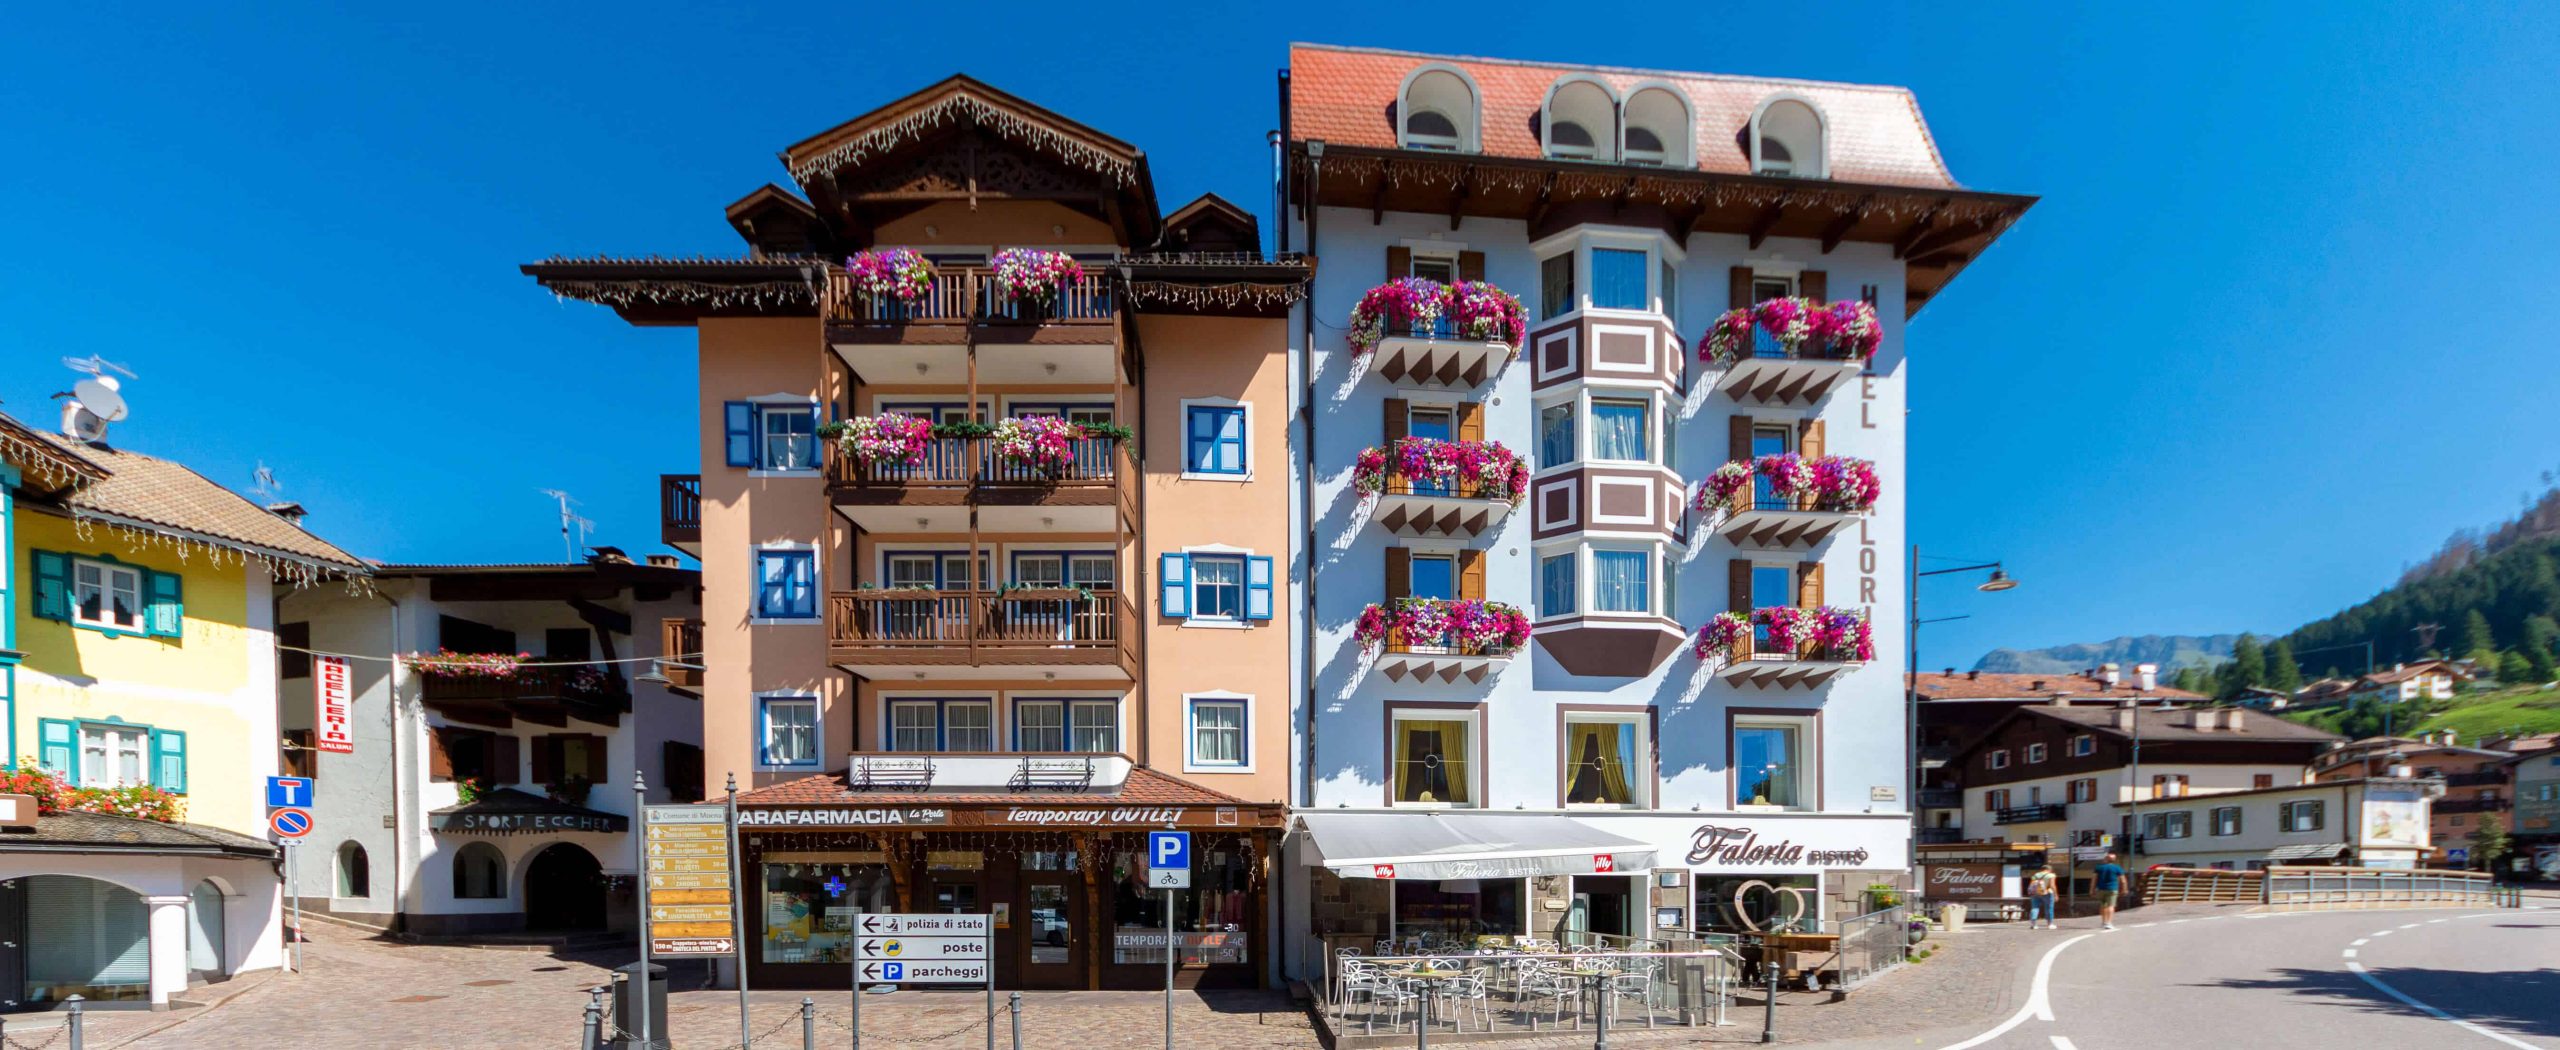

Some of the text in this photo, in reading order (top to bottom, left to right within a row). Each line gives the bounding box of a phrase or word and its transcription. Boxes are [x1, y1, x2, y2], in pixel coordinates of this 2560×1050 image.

[1861, 284, 1877, 429] HEL
[325, 656, 346, 740] MACELLERIA
[320, 742, 352, 751] SALUMI
[464, 814, 523, 829] SPORT
[736, 809, 903, 825] ARAFARMACIA
[1007, 807, 1106, 824] Temporary
[1158, 836, 1182, 865] P
[1690, 824, 1869, 862] Faloria BISTRÒ
[1376, 866, 1394, 877] illy
[1447, 862, 1542, 878] Faloria BISTRÒ
[1594, 857, 1612, 871] illy
[1931, 866, 1996, 884] Faloria
[1949, 886, 1984, 894] BISTRÒ
[907, 919, 983, 930] polizia di stato
[943, 943, 983, 954] poste
[888, 965, 983, 978] P parcheggi
